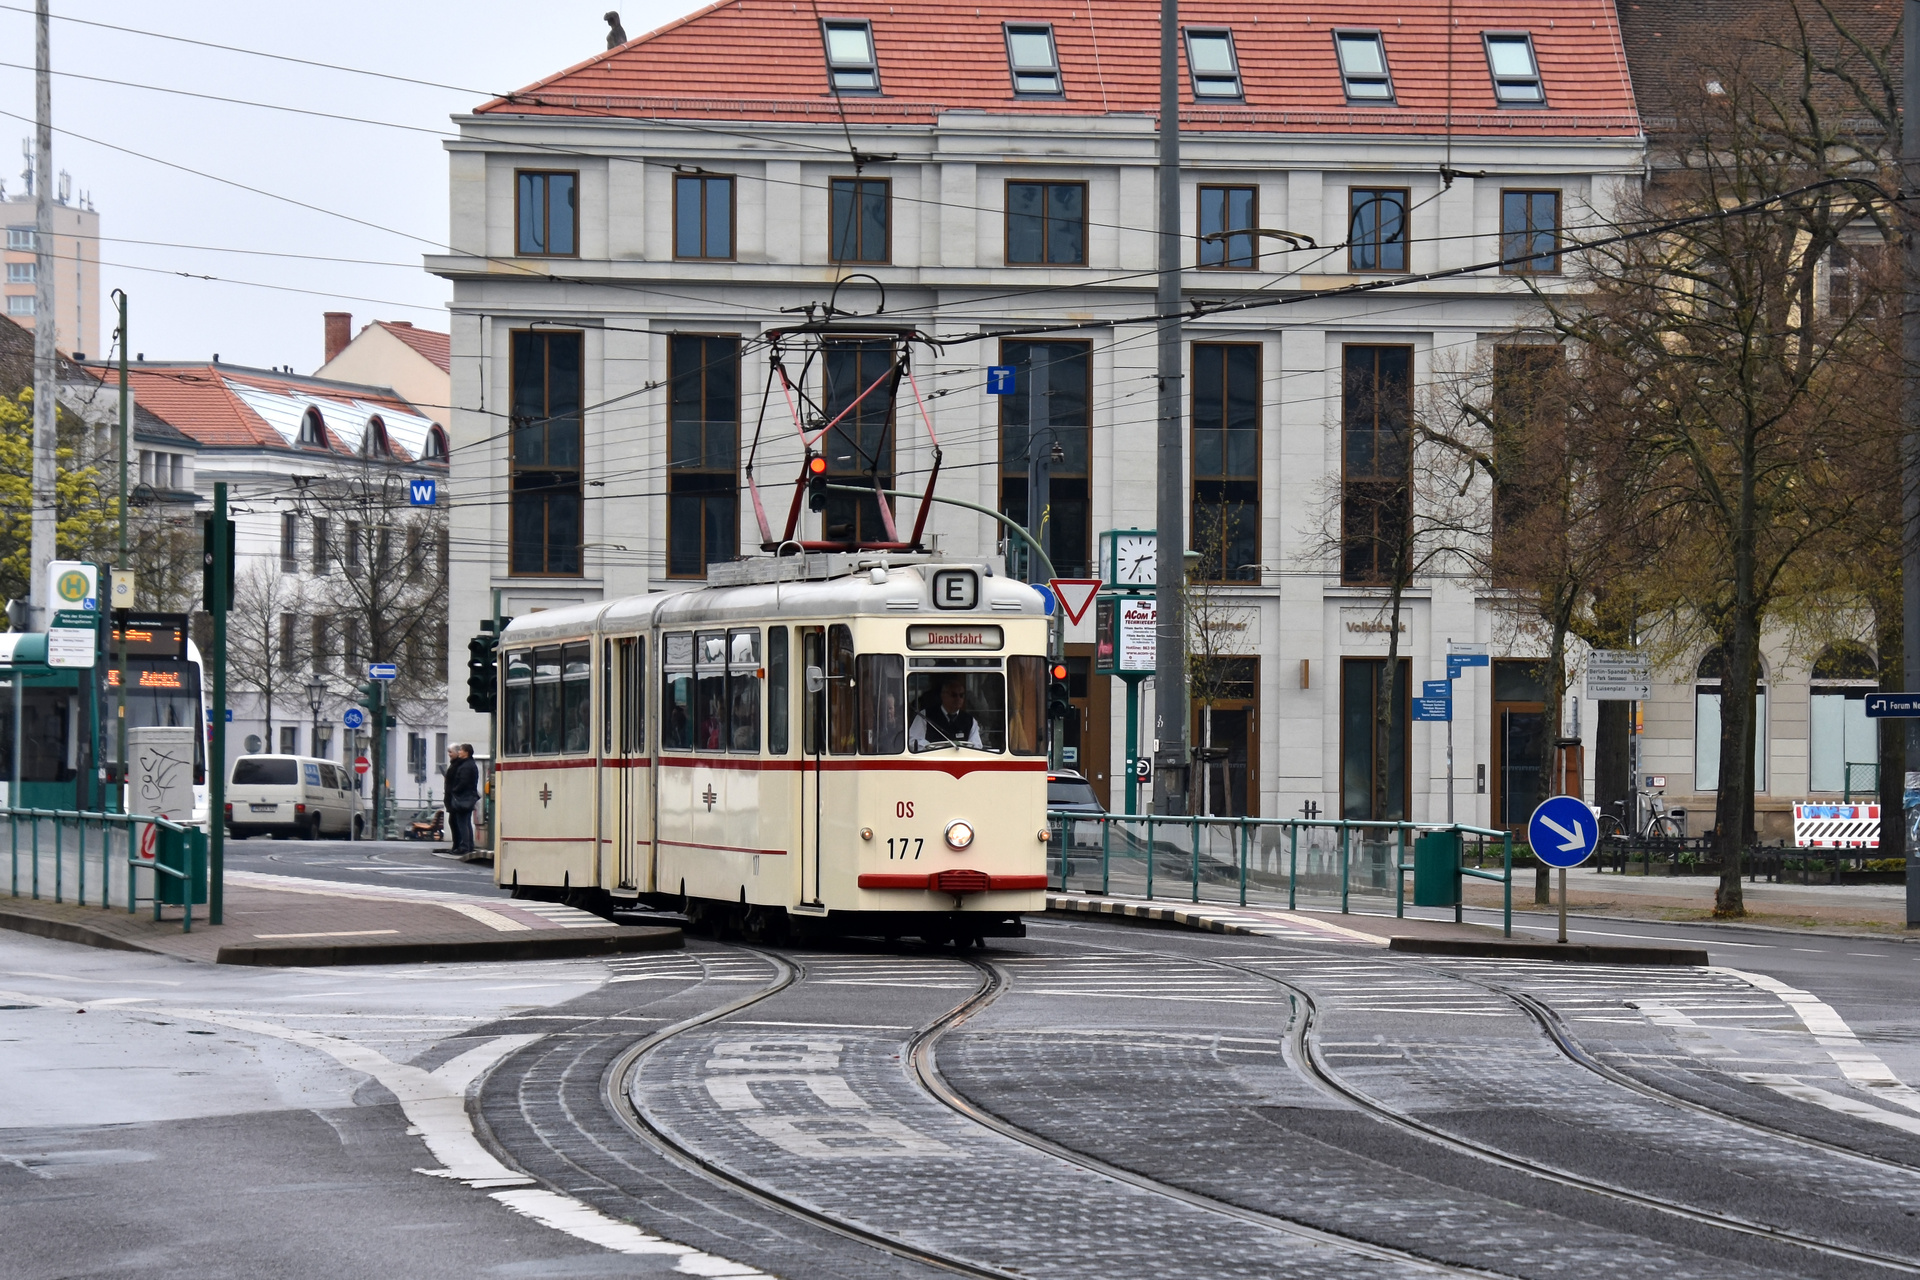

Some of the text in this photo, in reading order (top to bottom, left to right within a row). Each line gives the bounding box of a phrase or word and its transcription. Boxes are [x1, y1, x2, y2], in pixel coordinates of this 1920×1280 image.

[993, 370, 1009, 390] T
[412, 486, 432, 501] W
[946, 578, 963, 600] E
[1202, 620, 1247, 631] Berliner
[1346, 621, 1406, 633] Volksbak
[928, 632, 983, 645] Dienstfahrt
[1890, 702, 1911, 710] Forum
[896, 801, 914, 818] OS
[887, 838, 924, 859] 177
